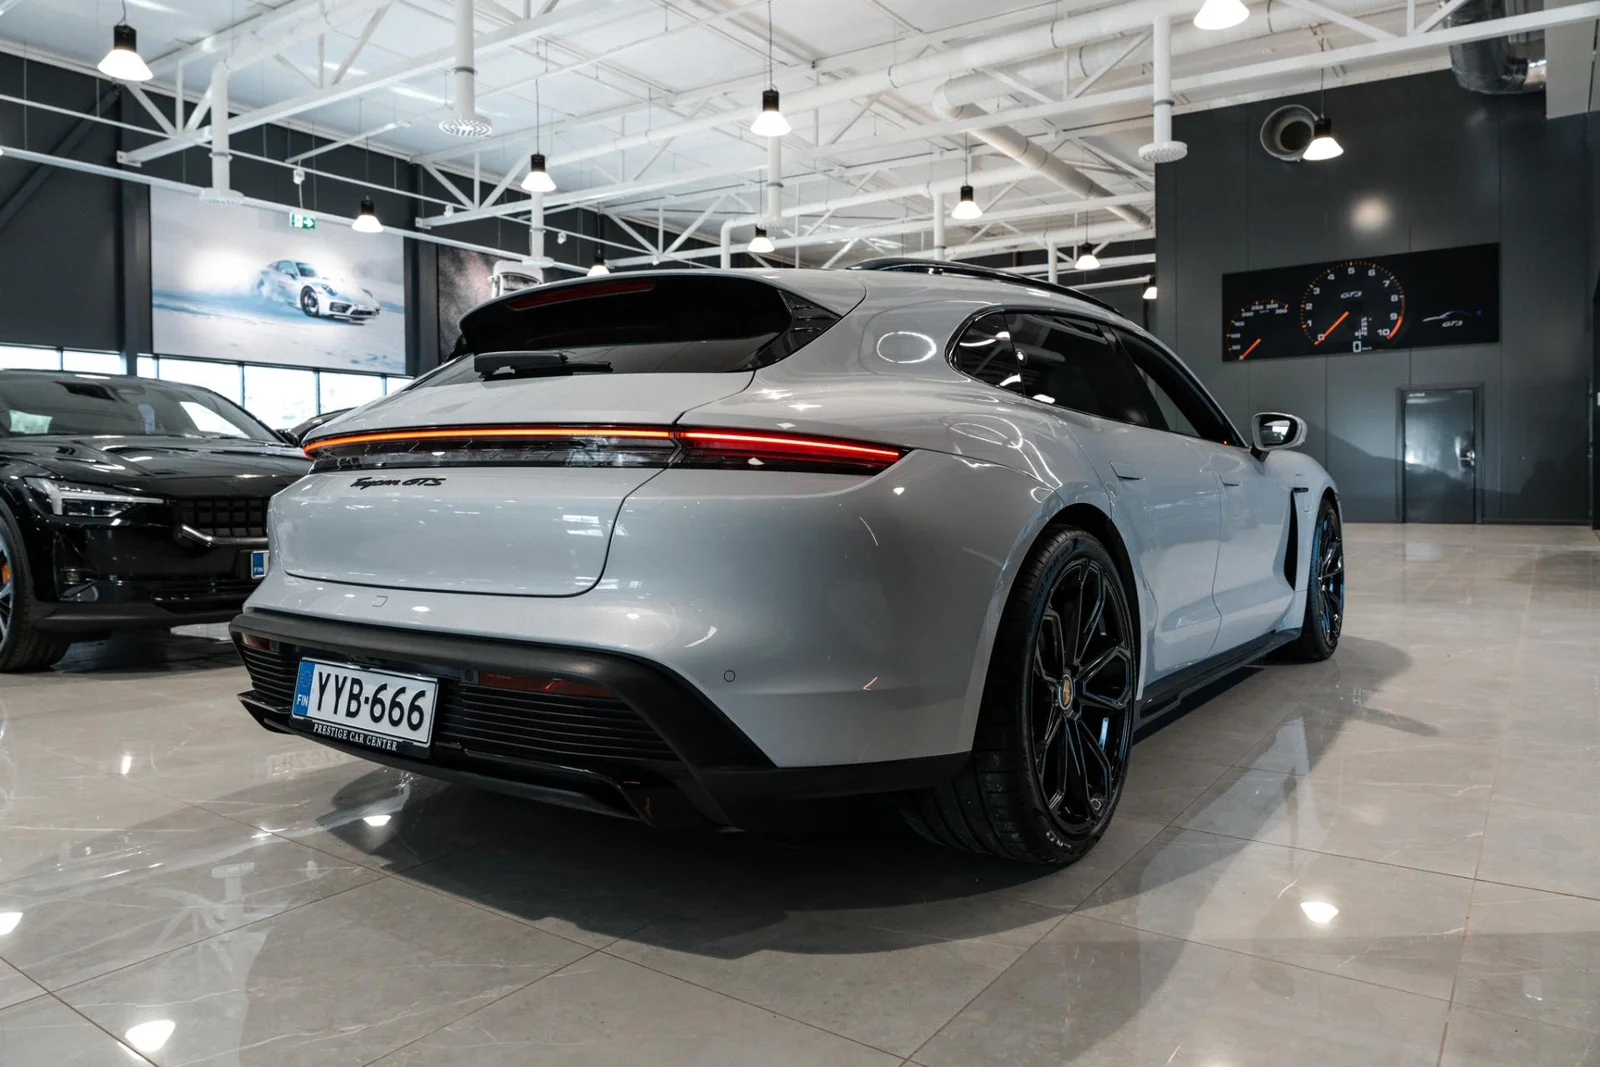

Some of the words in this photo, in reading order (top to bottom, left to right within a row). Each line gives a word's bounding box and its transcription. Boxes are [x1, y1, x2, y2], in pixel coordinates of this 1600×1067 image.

[1347, 266, 1355, 275] 5
[1368, 268, 1376, 277] 6
[1327, 273, 1335, 281] 4
[1382, 279, 1391, 288] 7
[1312, 286, 1321, 295] 3
[1340, 290, 1363, 299] GT3
[1390, 294, 1399, 303] 8
[1305, 302, 1313, 311] 2
[1389, 312, 1398, 321] 9
[1306, 319, 1312, 328] 1
[1441, 319, 1464, 328] GT3
[1376, 328, 1390, 337] 10
[401, 477, 447, 486] GTS
[296, 694, 310, 707] FIN
[317, 671, 427, 732] YYB-666
[313, 723, 348, 740] PRESTIGE
[349, 731, 364, 744] CAR
[366, 735, 398, 751] CENTER
